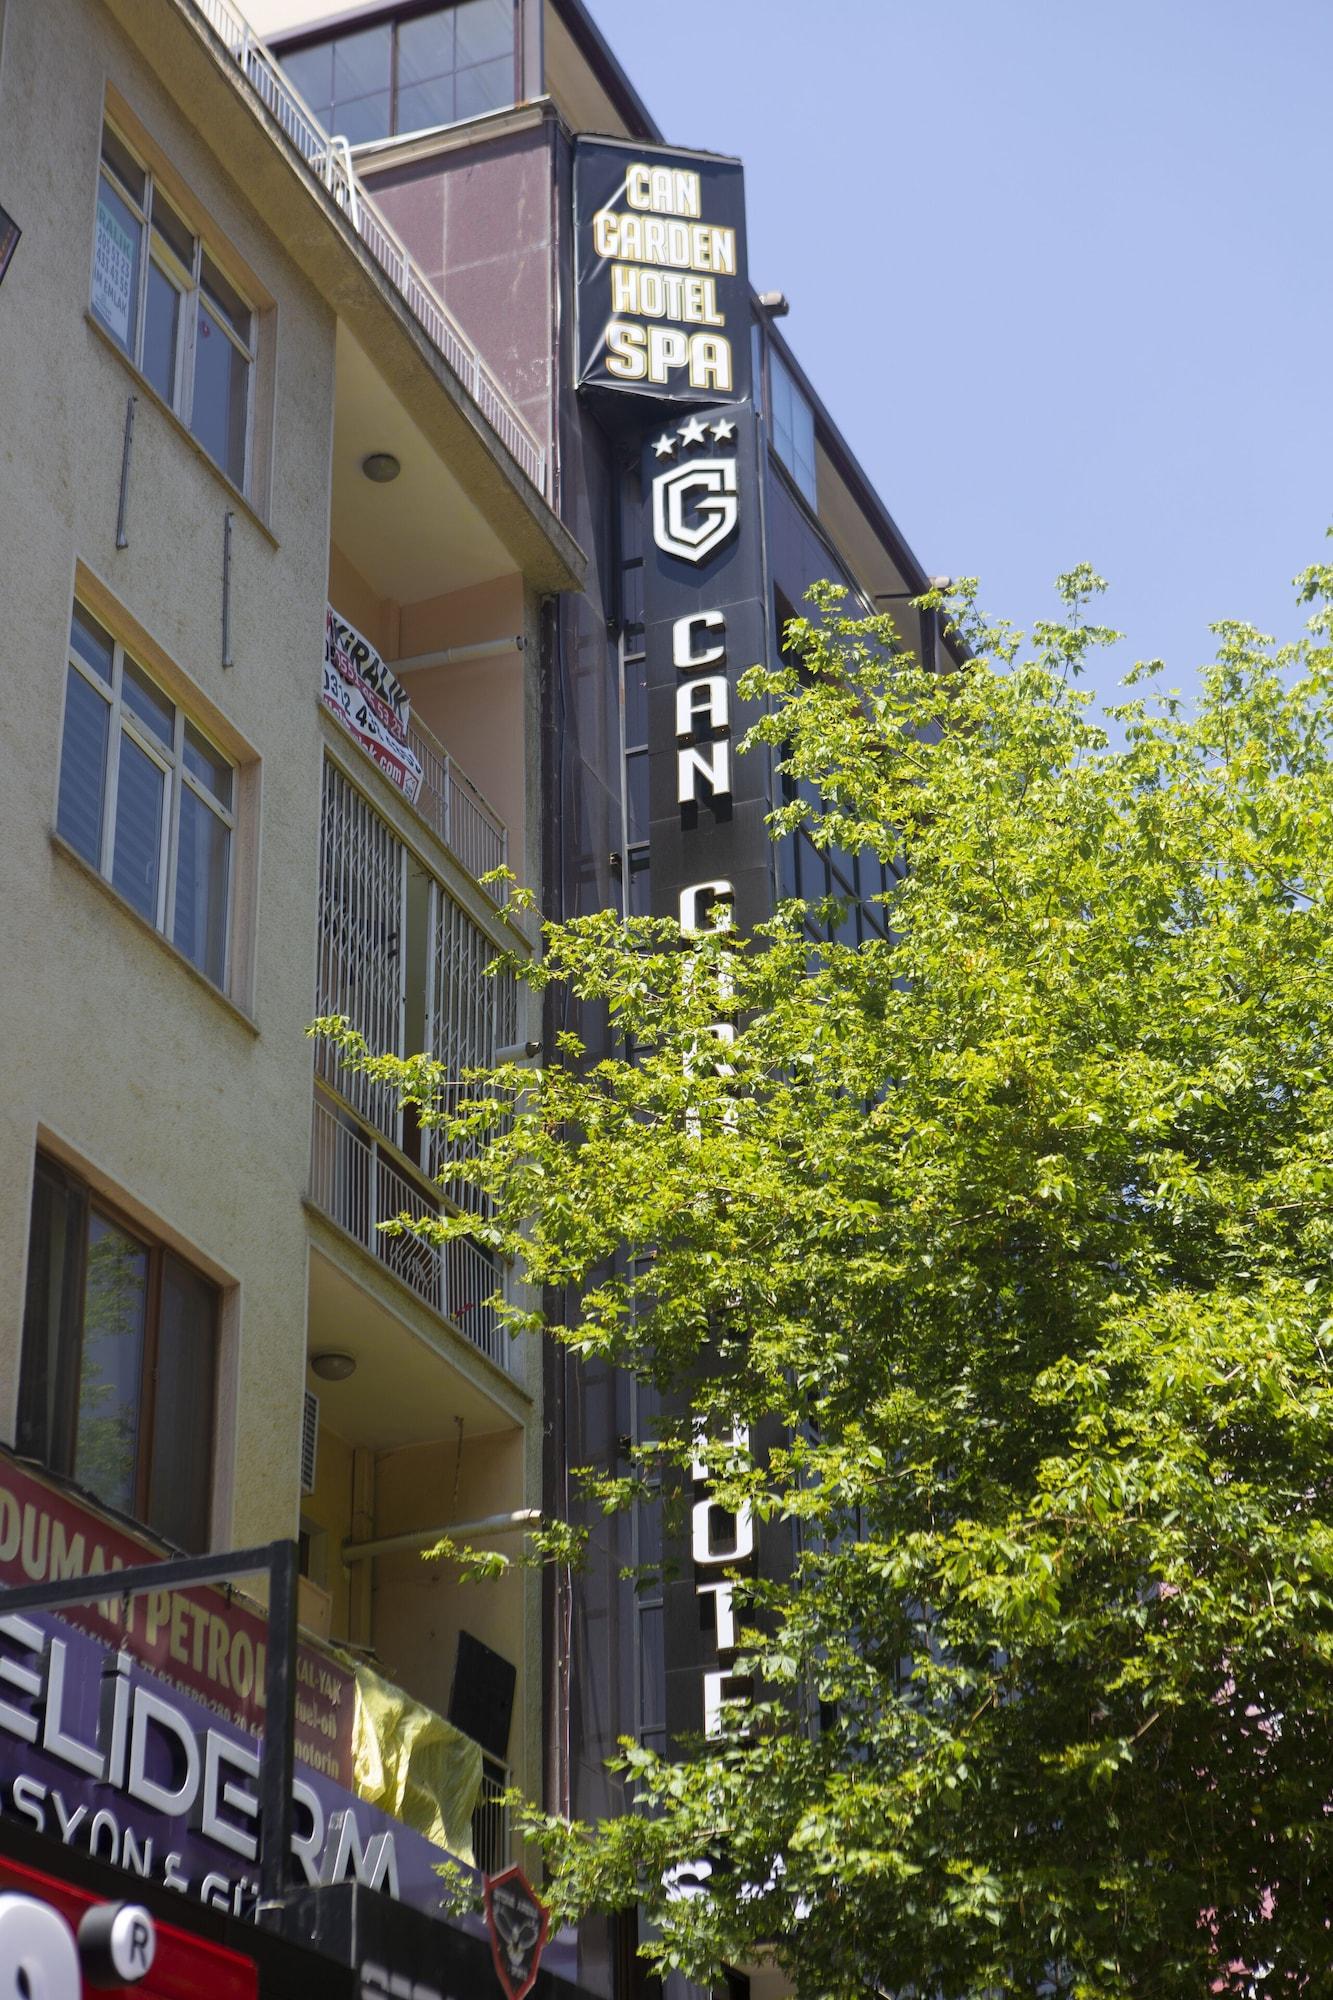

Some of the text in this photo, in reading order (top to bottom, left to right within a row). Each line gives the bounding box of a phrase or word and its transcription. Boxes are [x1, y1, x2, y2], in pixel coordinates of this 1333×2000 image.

[625, 162, 702, 219] CAN
[593, 208, 737, 275] GARDEN
[611, 264, 726, 328] HOTEL
[606, 319, 734, 392] SPA
[672, 610, 731, 803] CAN
[145, 1586, 267, 1709] PETROL
